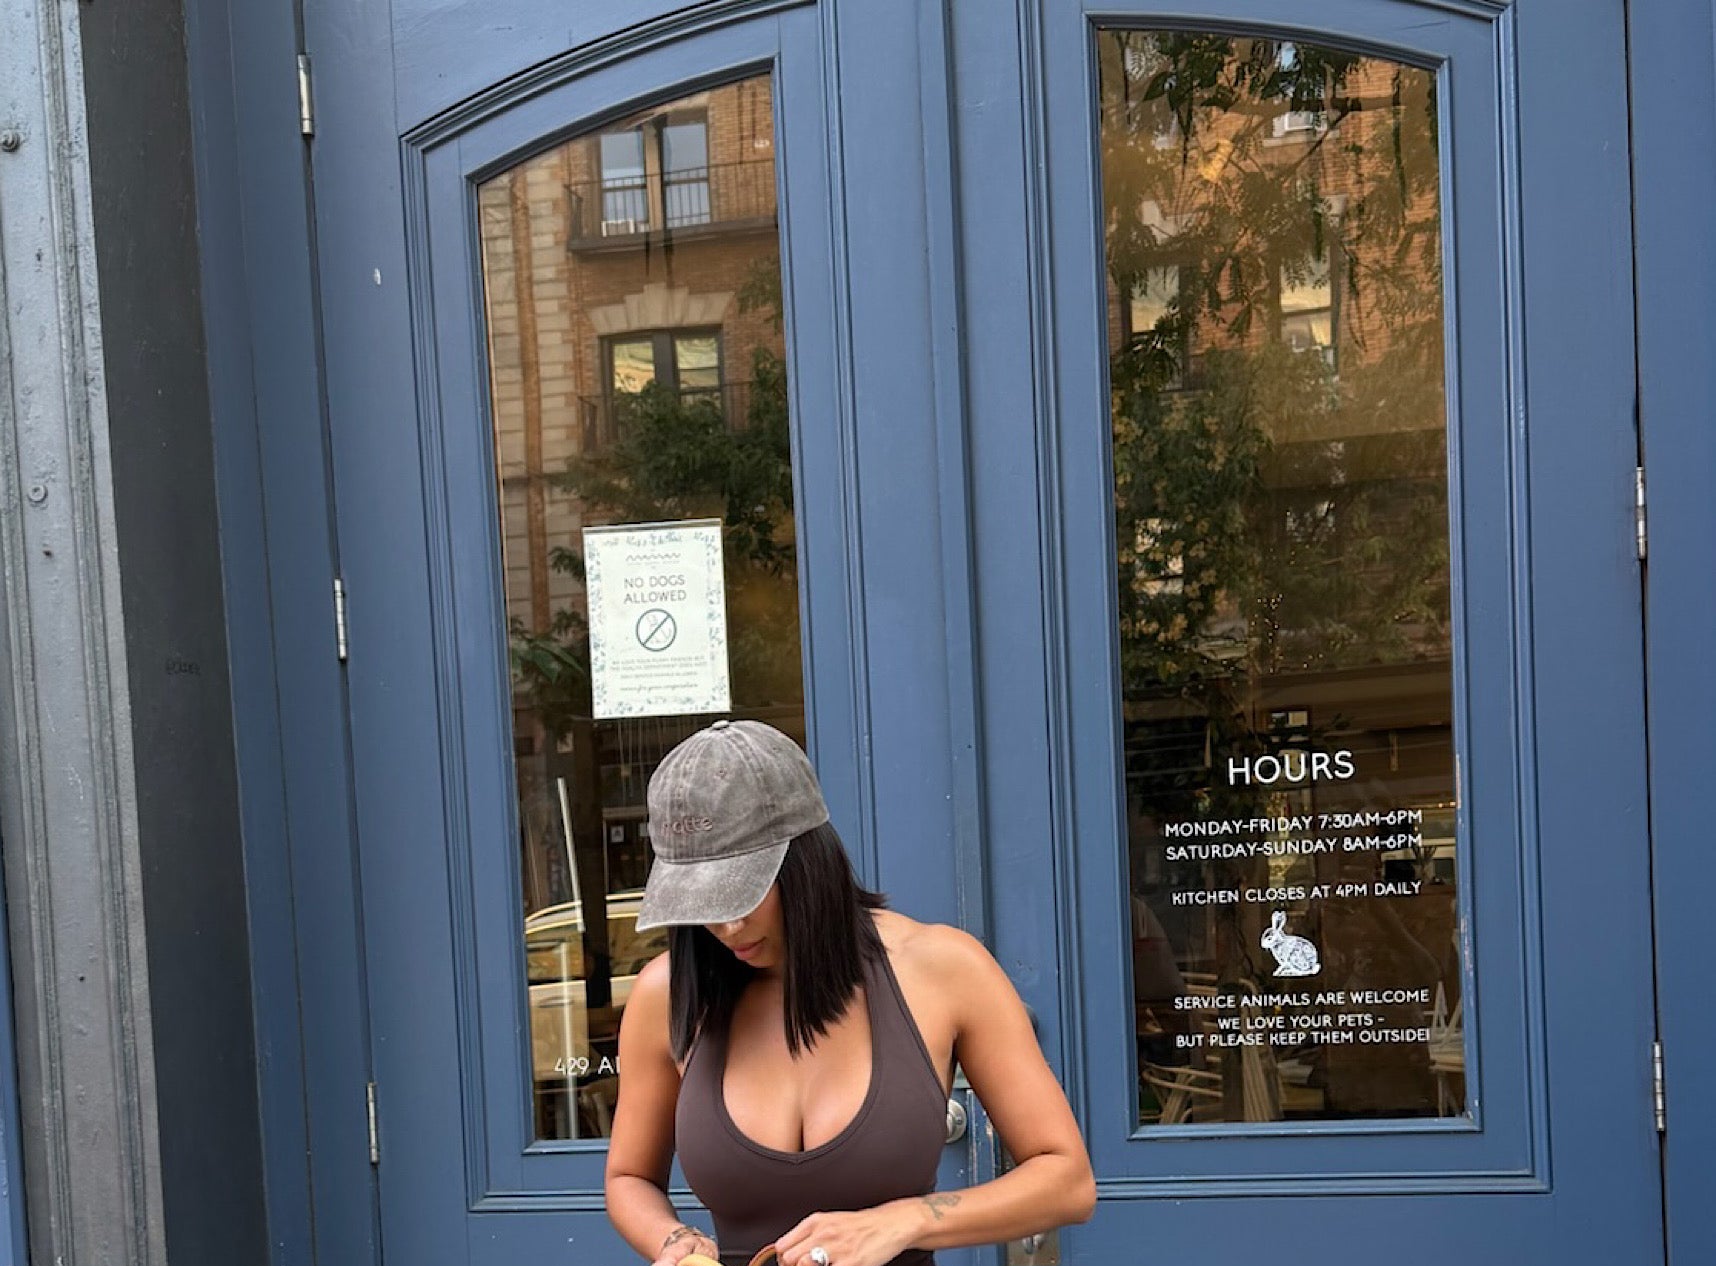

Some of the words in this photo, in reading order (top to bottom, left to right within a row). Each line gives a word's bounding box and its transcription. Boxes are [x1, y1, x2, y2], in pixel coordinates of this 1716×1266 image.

[623, 576, 644, 589] NO
[649, 574, 685, 588] DOGS
[623, 589, 687, 604] ALLOWED
[1228, 750, 1355, 786] HOURS
[1164, 814, 1313, 838] MONDAY-FRIDAY
[1317, 809, 1423, 830] 7:30AM-6PM
[1165, 838, 1337, 861] SATURDAY-SUNDAY
[1342, 833, 1424, 852] 8AM-6PM
[1171, 889, 1239, 906] KITCHEN
[1244, 885, 1306, 903] CLOSES
[1309, 884, 1331, 899] AT
[1335, 883, 1368, 898] 4PM
[1373, 880, 1423, 897] DAILY
[1173, 994, 1236, 1010] SERVICE
[1239, 992, 1311, 1009] ANIMALS
[1314, 991, 1346, 1006] ARE
[1349, 988, 1431, 1005] WELCOME
[1217, 1016, 1241, 1031] WE
[1245, 1015, 1286, 1030] LOVE
[1288, 1014, 1334, 1029] YOUR
[1337, 1012, 1375, 1028] PETS
[1174, 1033, 1204, 1049] BUT
[1208, 1032, 1265, 1048] PLEASE
[1268, 1030, 1307, 1046] KEEP
[1309, 1028, 1355, 1045] THEM
[553, 1055, 591, 1076] 429
